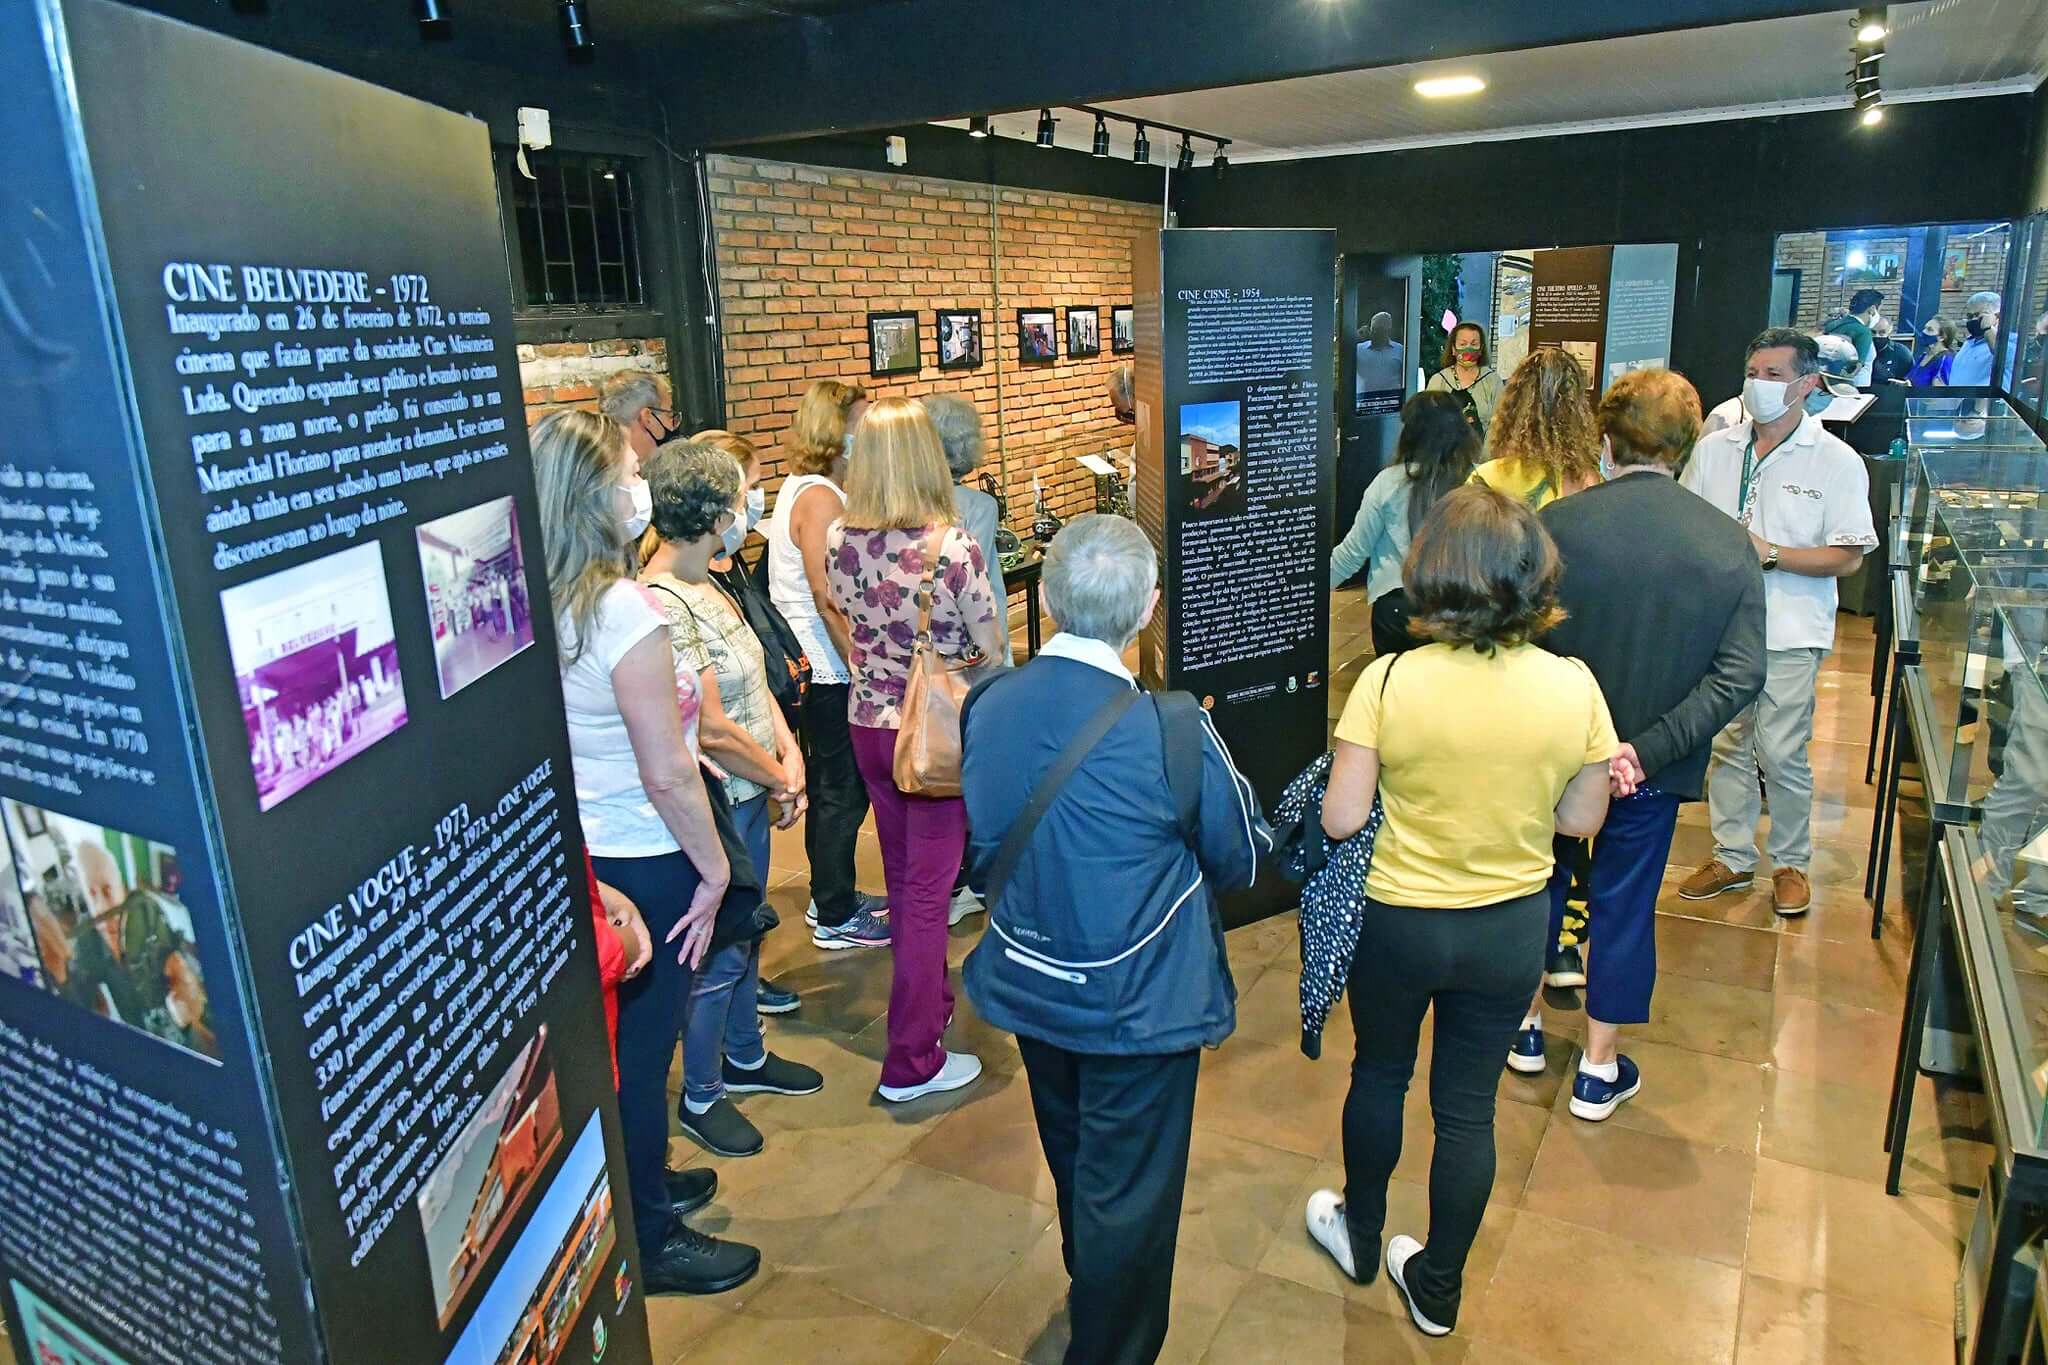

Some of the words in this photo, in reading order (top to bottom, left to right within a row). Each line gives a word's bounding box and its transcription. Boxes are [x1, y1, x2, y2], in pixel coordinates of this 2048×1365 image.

[162, 262, 237, 302] CINE
[242, 266, 370, 303] BELVEDERE
[391, 274, 429, 303] 1972
[1177, 289, 1201, 300] CINE
[1203, 289, 1231, 299] CISNE
[1241, 288, 1261, 298] 1954
[289, 904, 346, 969] CINE
[348, 846, 417, 916] VOGUE
[435, 803, 469, 849] 1973
